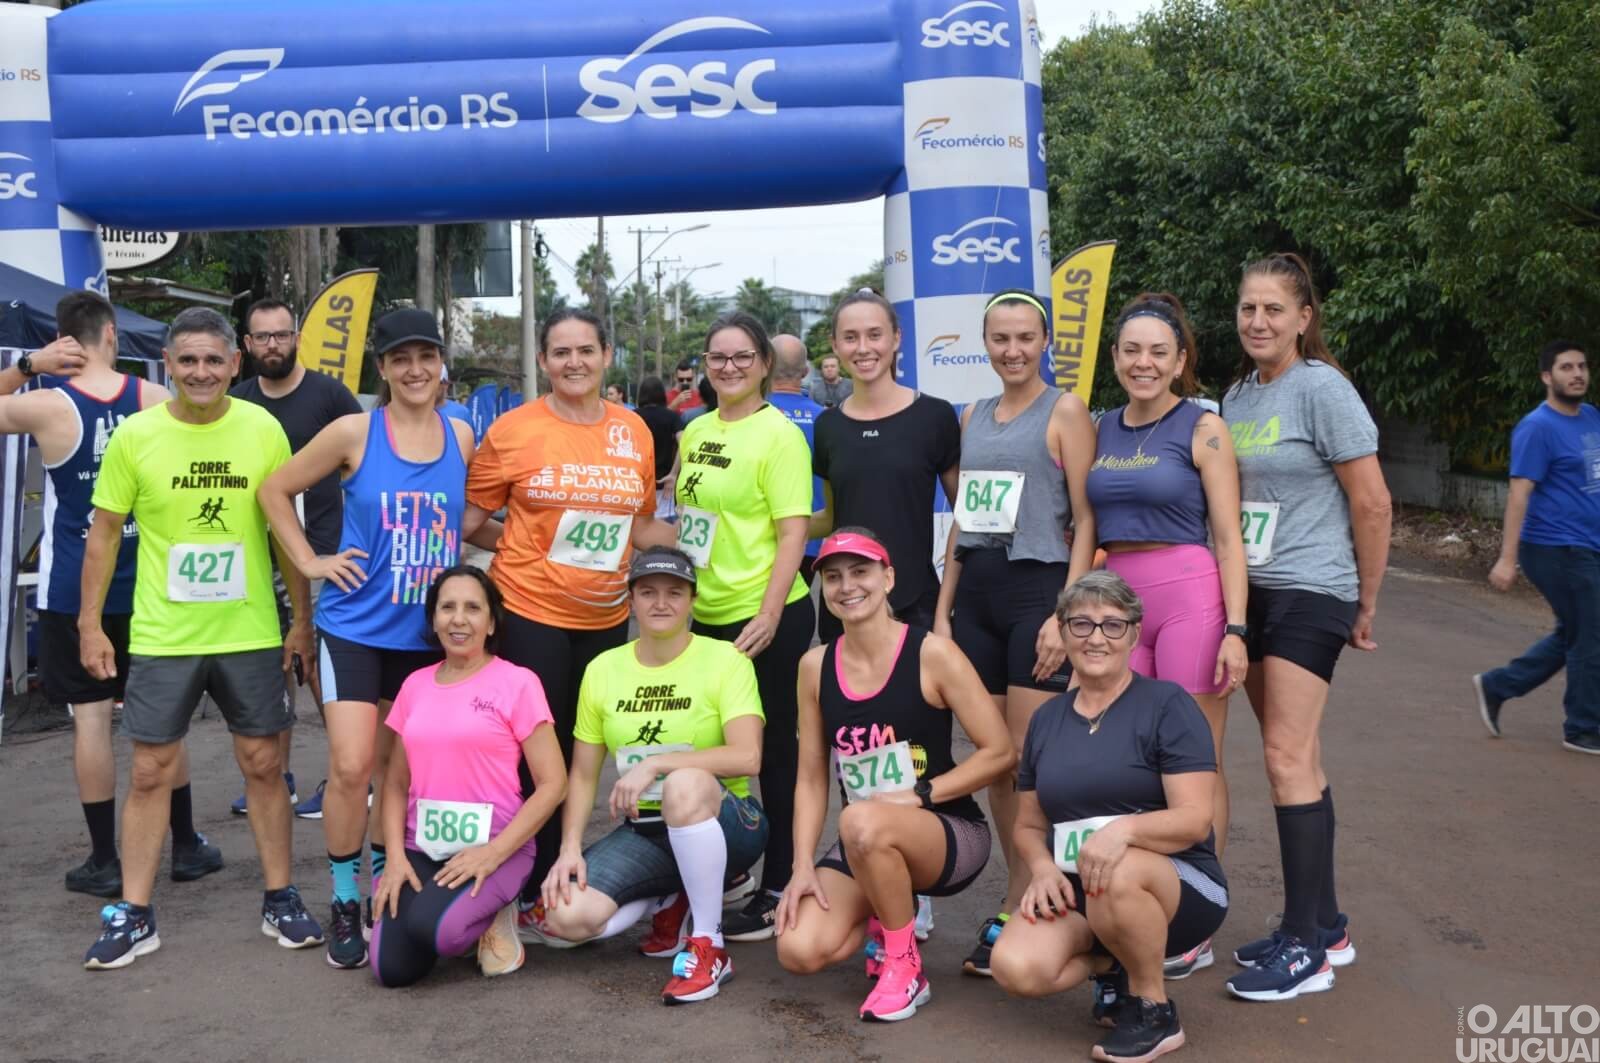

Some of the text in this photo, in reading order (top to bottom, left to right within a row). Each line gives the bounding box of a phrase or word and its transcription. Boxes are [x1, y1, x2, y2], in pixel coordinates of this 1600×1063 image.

[919, 17, 1011, 49] Sesc
[20, 68, 41, 81] RS
[576, 57, 777, 123] Sesc
[202, 92, 519, 140] Fecomércio RS
[921, 134, 1005, 150] Fecomércio
[1008, 135, 1025, 149] RS
[894, 250, 908, 264] RS
[931, 234, 1021, 266] Sesc
[862, 429, 879, 438] FILA
[190, 461, 231, 475] CORRE
[561, 463, 640, 479] RÚSTICA
[172, 475, 249, 489] PALMITINHO
[529, 475, 555, 487] DE
[527, 489, 567, 500] RUMO
[570, 492, 600, 503] AOS
[602, 494, 621, 504] 60
[965, 479, 1013, 512] 647
[565, 521, 621, 552] 493
[677, 514, 710, 548] 23
[391, 528, 457, 567] BURN
[178, 550, 235, 583] 427
[635, 685, 677, 699] CORRE
[616, 697, 692, 712] PALMITINHO
[842, 752, 904, 790] 374
[423, 809, 480, 844] 586
[1289, 954, 1312, 977] FILA
